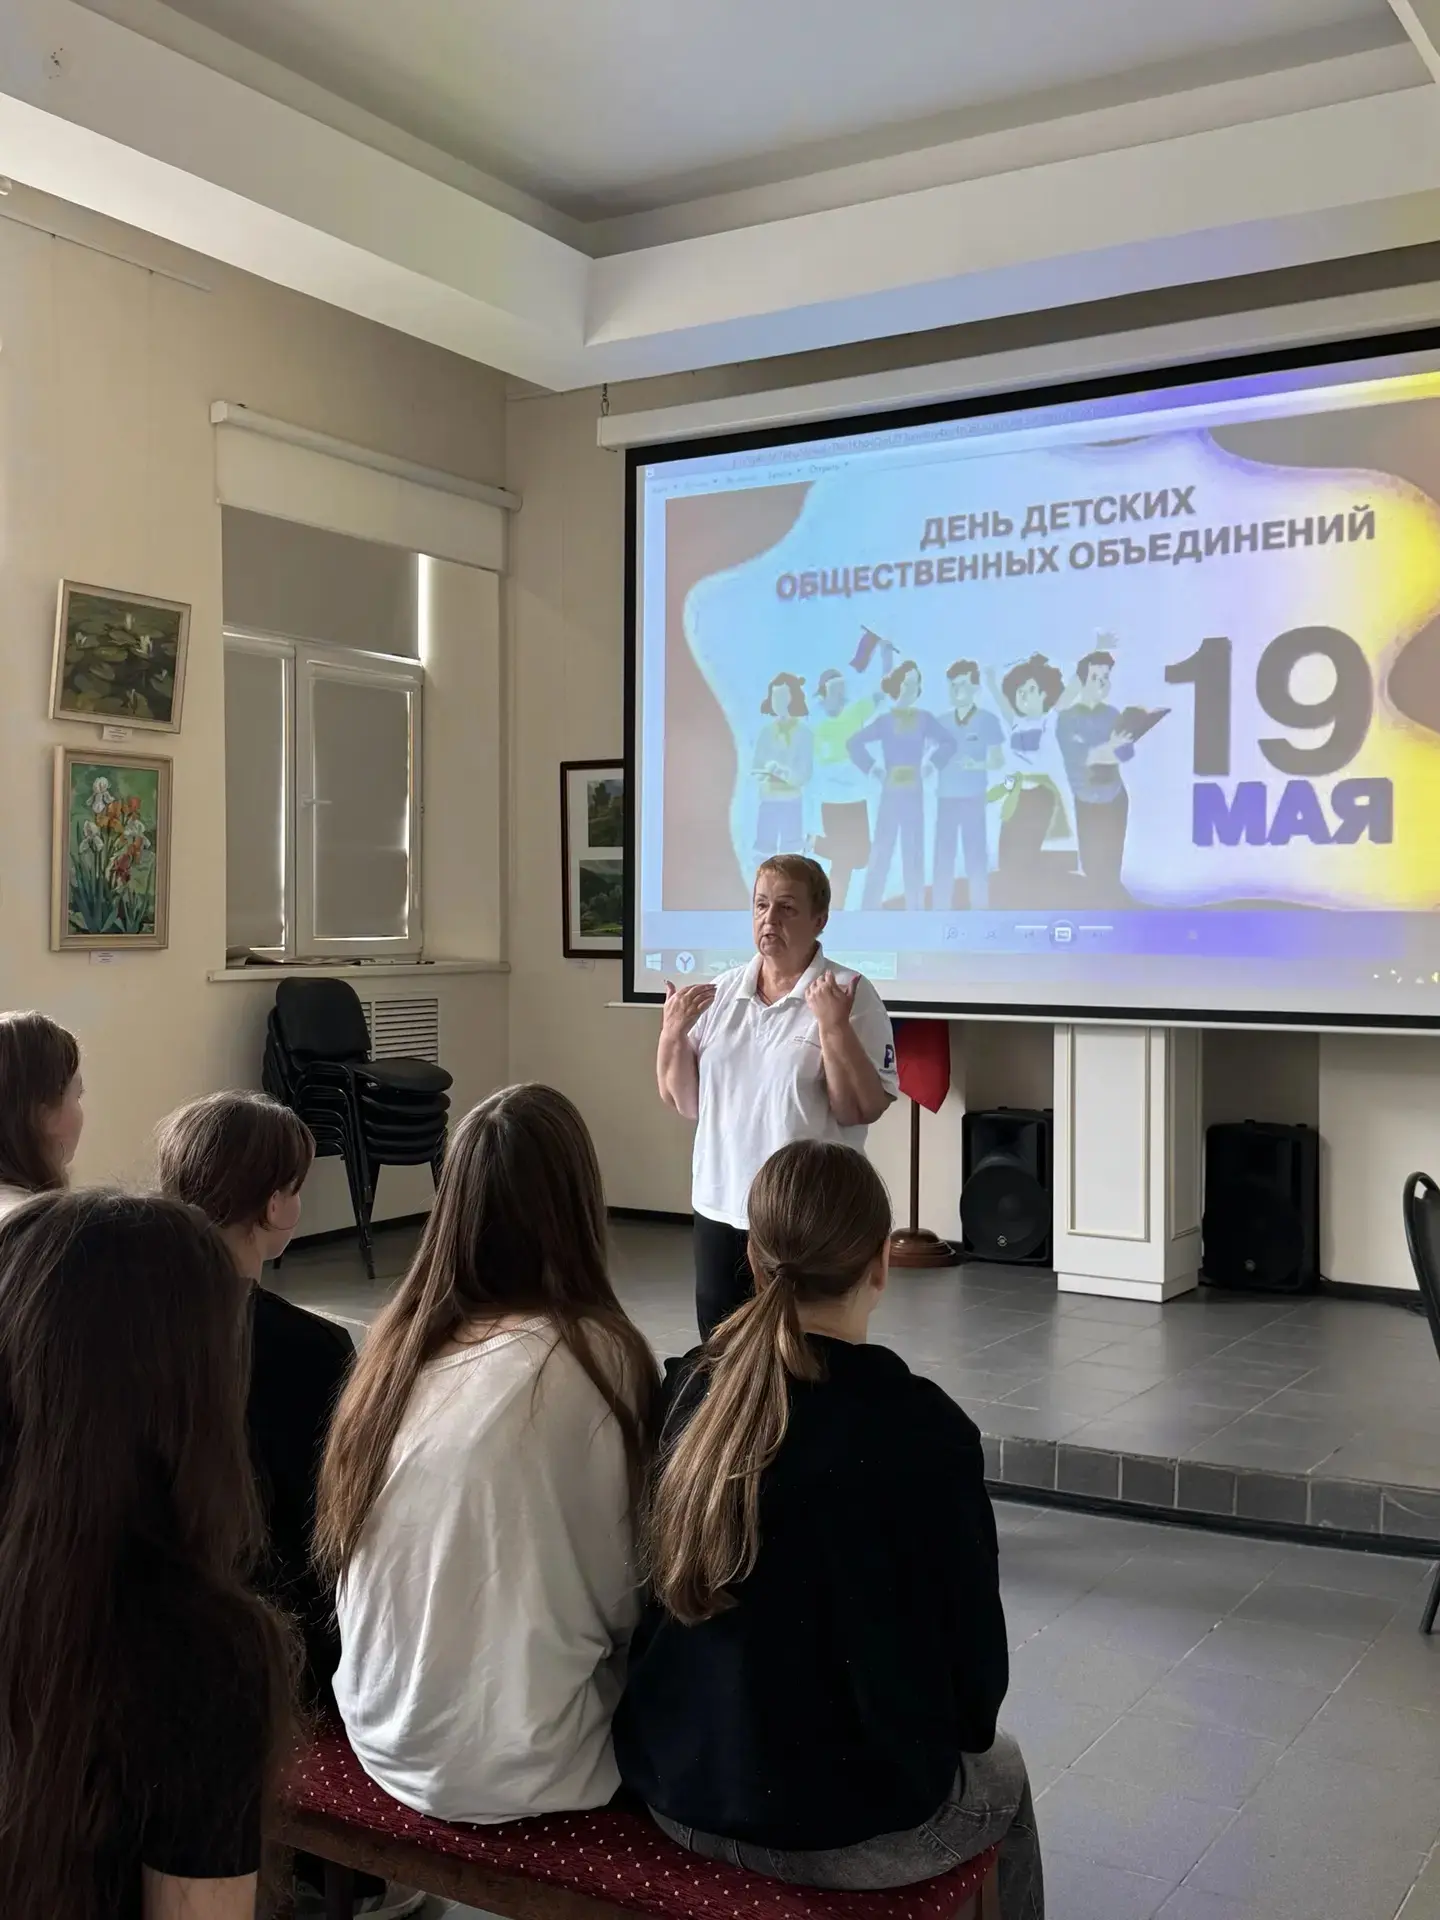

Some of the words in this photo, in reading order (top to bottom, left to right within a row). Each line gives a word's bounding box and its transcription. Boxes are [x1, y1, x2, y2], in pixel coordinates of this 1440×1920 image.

[776, 545, 1058, 601] ОБЩЕСТВЕННЫХ
[1068, 504, 1375, 569] ОБЪЕДИНЕНИЙ
[920, 510, 1013, 551] ДЕНЬ
[1020, 485, 1196, 539] ДЕТСКИХ
[1165, 625, 1374, 777] 19
[1192, 777, 1394, 847] МАЯ
